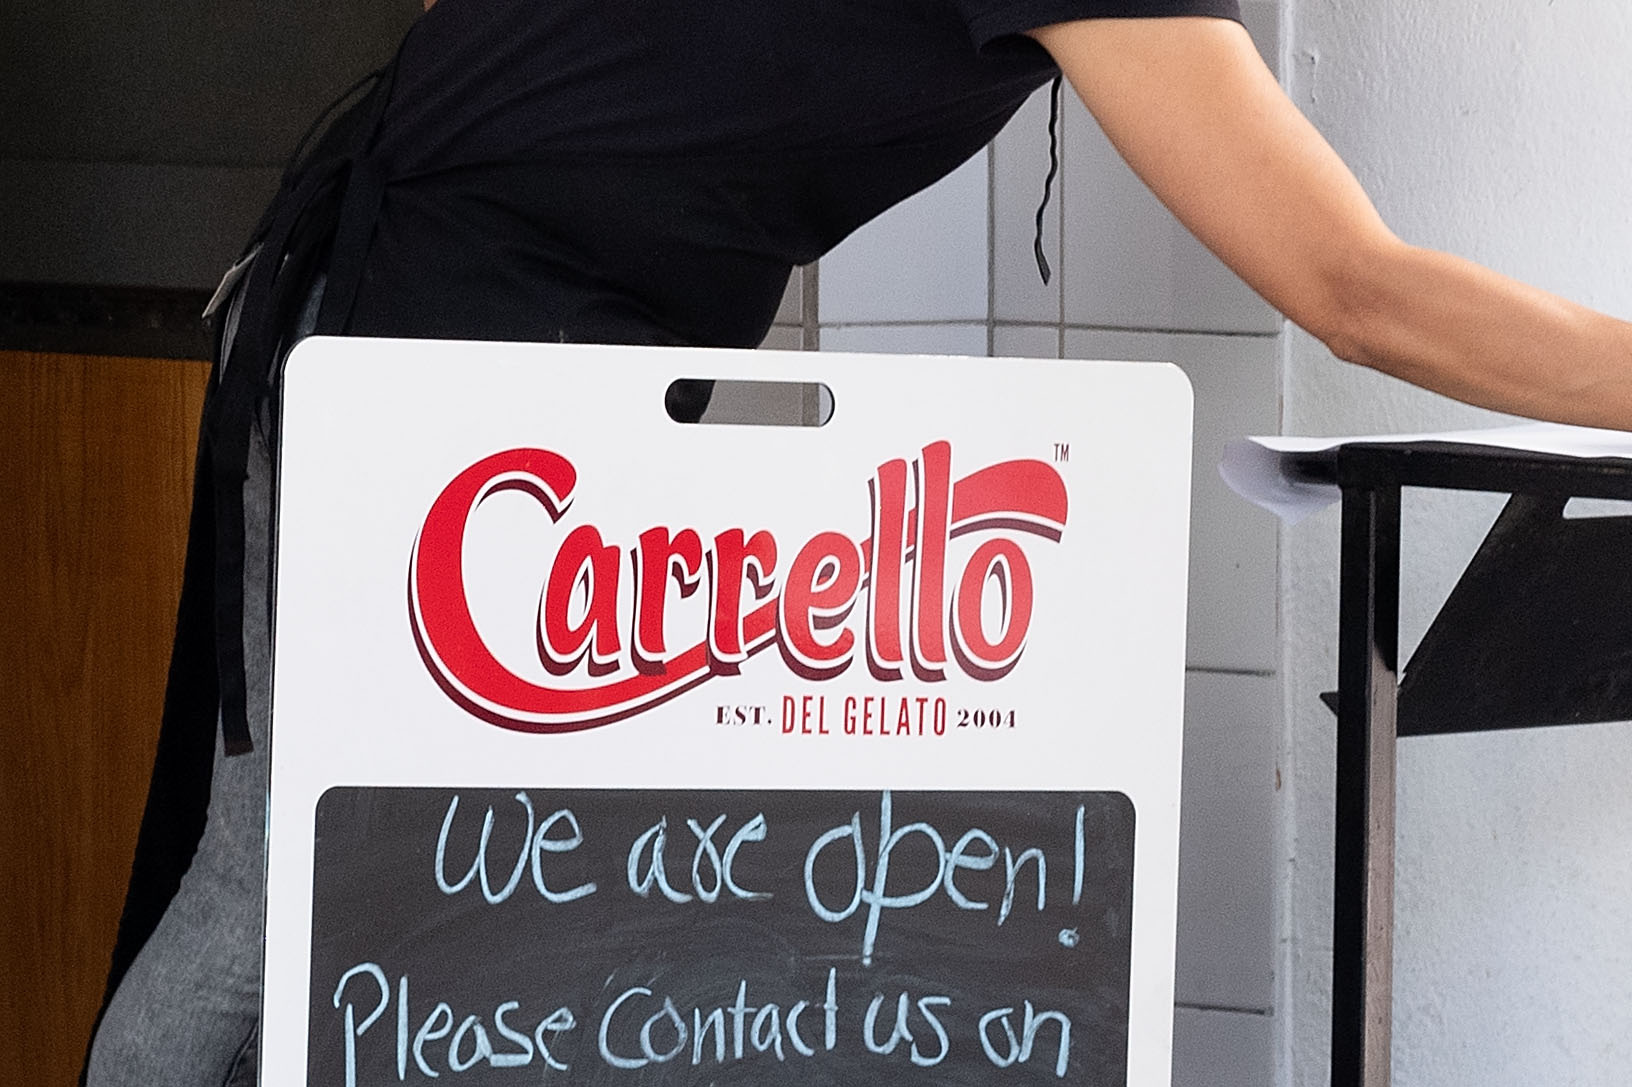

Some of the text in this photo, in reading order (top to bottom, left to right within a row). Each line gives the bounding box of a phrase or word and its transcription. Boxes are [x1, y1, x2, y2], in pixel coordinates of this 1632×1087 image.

[407, 440, 1069, 735] Carrello
[715, 695, 1016, 736] EST. DEL GELATO 2004
[434, 789, 1086, 966] We are open!
[333, 962, 577, 1087] Please
[863, 991, 951, 1067] us
[978, 999, 1071, 1078] on
